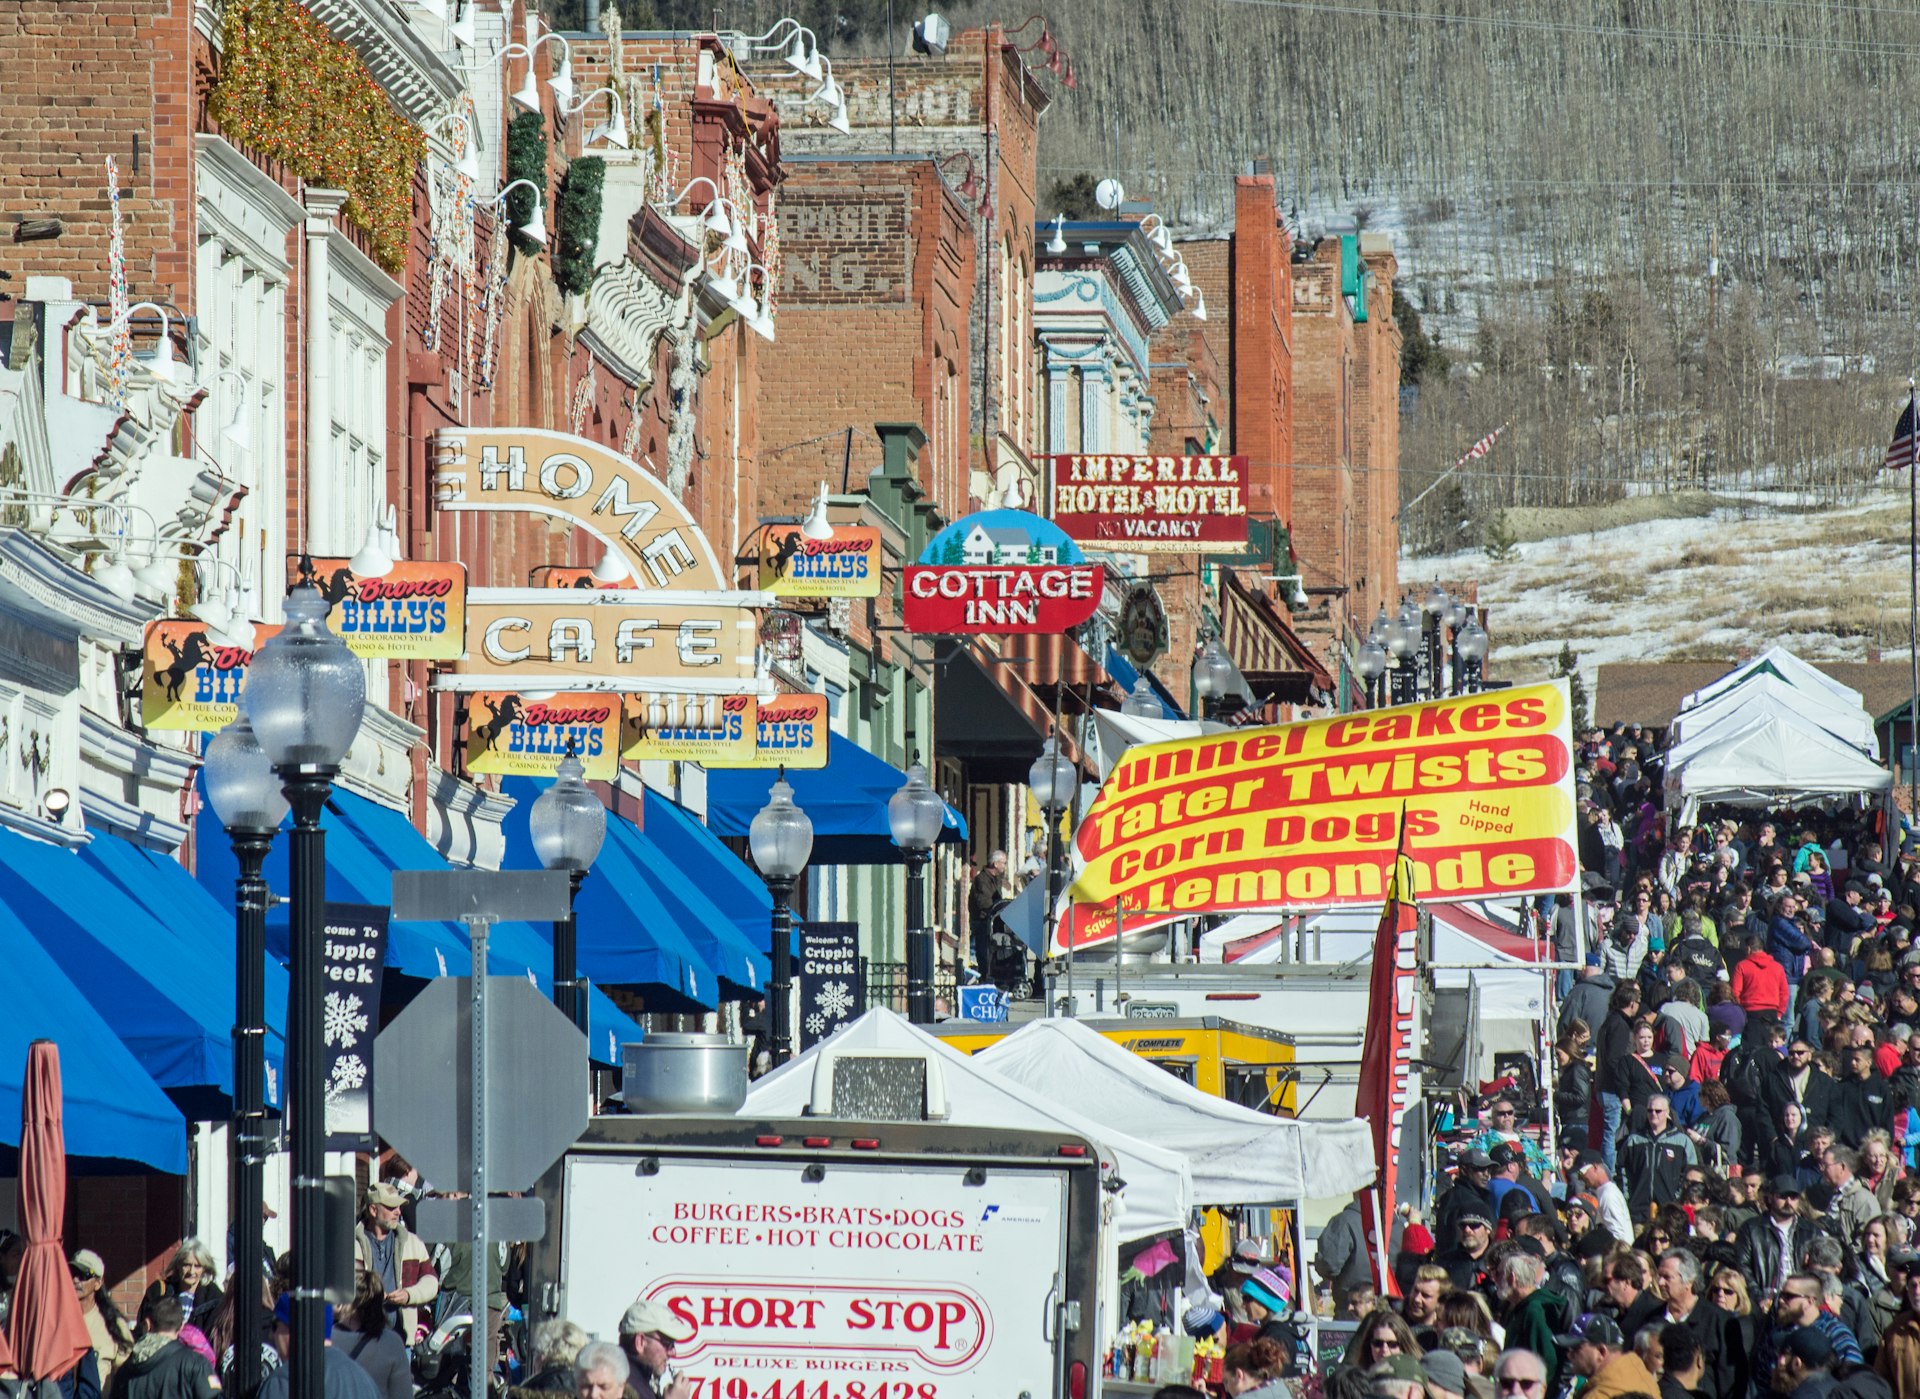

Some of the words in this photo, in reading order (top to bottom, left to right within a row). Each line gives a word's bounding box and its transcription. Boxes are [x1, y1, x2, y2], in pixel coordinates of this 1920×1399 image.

[1070, 456, 1239, 482] IMPERIAL
[479, 446, 698, 588] HOME
[1123, 519, 1203, 537] VACANCY
[803, 538, 873, 557] Bronco
[1117, 542, 1143, 551] ROOM
[792, 553, 868, 578] BILLY'S
[358, 577, 453, 603] Bronco
[911, 570, 1094, 598] COTTAGE
[341, 597, 446, 634] BILLY'S
[966, 600, 1038, 625] INN
[358, 633, 407, 641] COLORADO
[409, 634, 433, 642] STYLE
[484, 617, 722, 665] CAFE
[187, 703, 212, 712] TRUE
[525, 703, 610, 726] Bronco
[195, 715, 233, 723] CASINO
[1325, 698, 1547, 748] Cakes
[509, 723, 603, 757] BILLY'S
[509, 762, 539, 770] CASINO
[1095, 777, 1265, 850] Tater
[1282, 747, 1547, 801] Twists
[1469, 799, 1511, 817] Hand
[1459, 814, 1514, 835] Dipped
[1109, 828, 1244, 885] Corn
[1264, 809, 1440, 848] Dogs
[363, 926, 379, 938] To
[805, 936, 839, 944] Welcome
[843, 936, 854, 944] To
[805, 946, 854, 959] Cripple
[804, 961, 855, 975] Creek
[1138, 1039, 1182, 1048] COMPLETE
[651, 1225, 750, 1246] COFFEE
[768, 1228, 820, 1248] HOT
[828, 1230, 984, 1252] CHOCOLATE
[666, 1295, 826, 1344] SHORT
[846, 1297, 966, 1350] STOP
[714, 1357, 799, 1370] DELUXE
[806, 1359, 911, 1373] BURGERS
